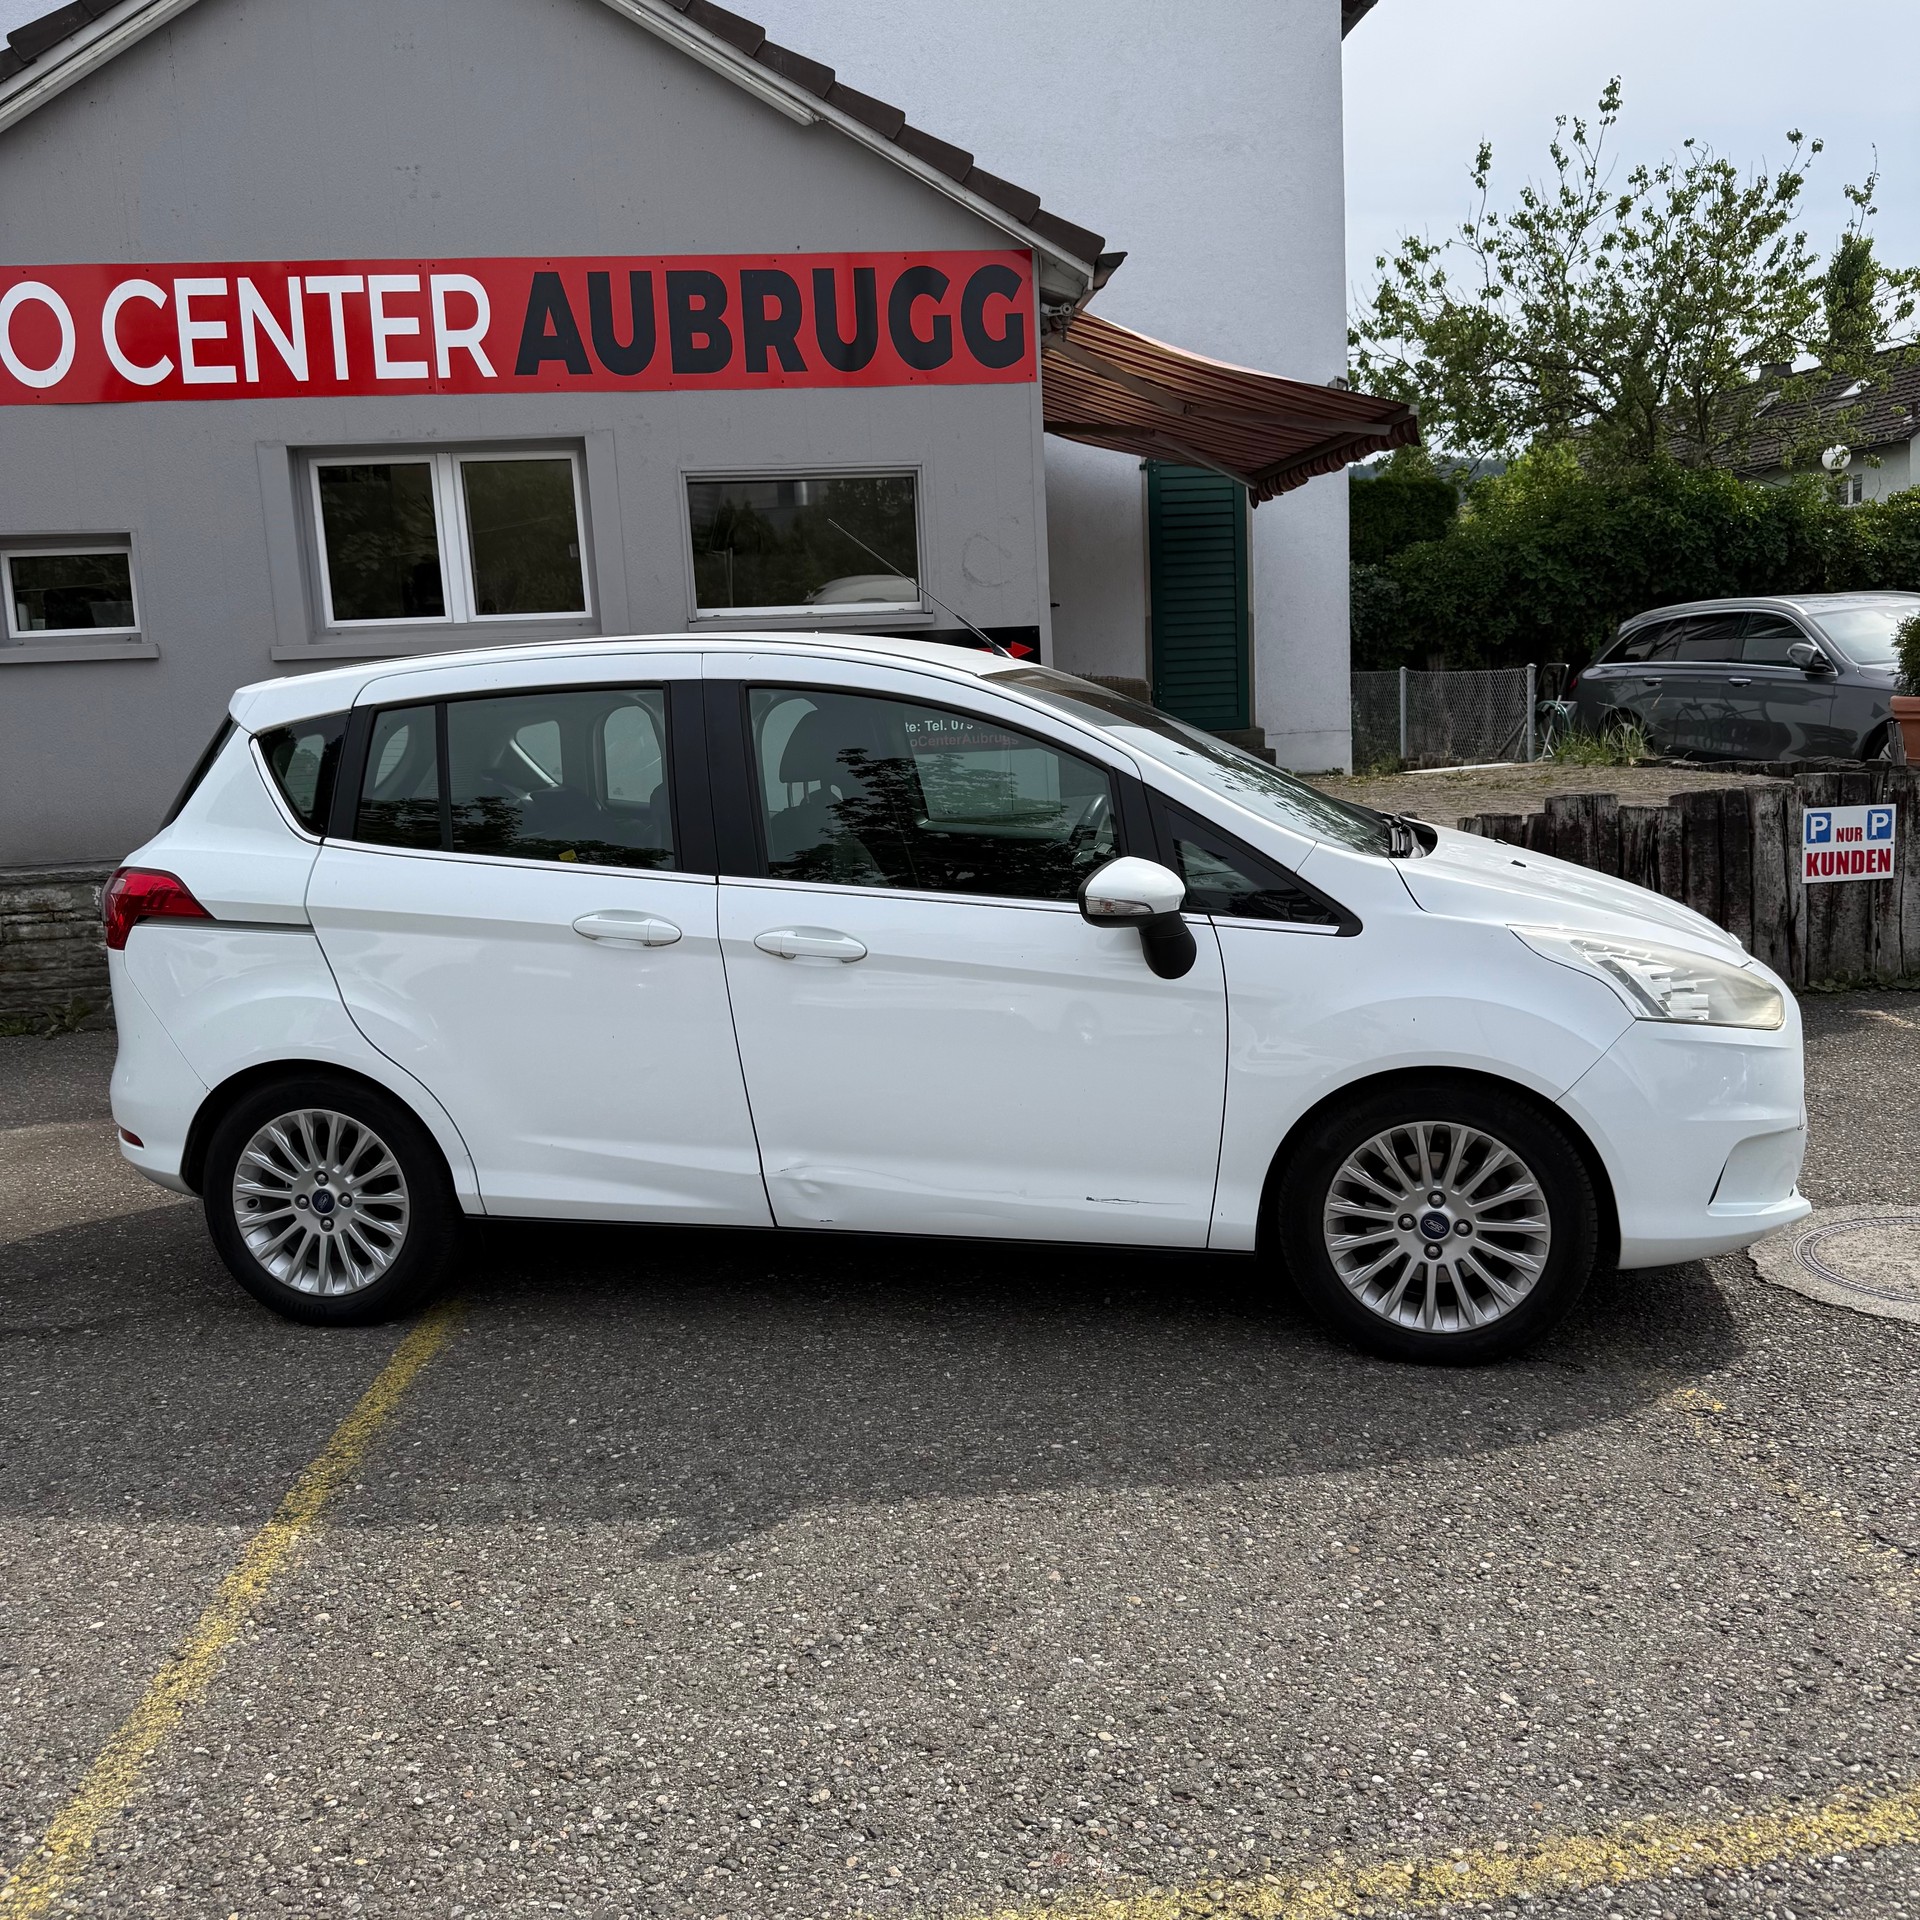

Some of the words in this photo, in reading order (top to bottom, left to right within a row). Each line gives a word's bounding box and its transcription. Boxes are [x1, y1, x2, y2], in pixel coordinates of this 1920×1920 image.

[0, 281, 76, 388] O
[102, 274, 498, 386] CENTER
[514, 264, 1025, 376] AUBRUGG
[925, 720, 947, 731] Tel.
[1811, 816, 1828, 840] P
[1836, 827, 1862, 842] NUR
[1872, 813, 1889, 836] P
[1806, 848, 1891, 877] KUNDEN
